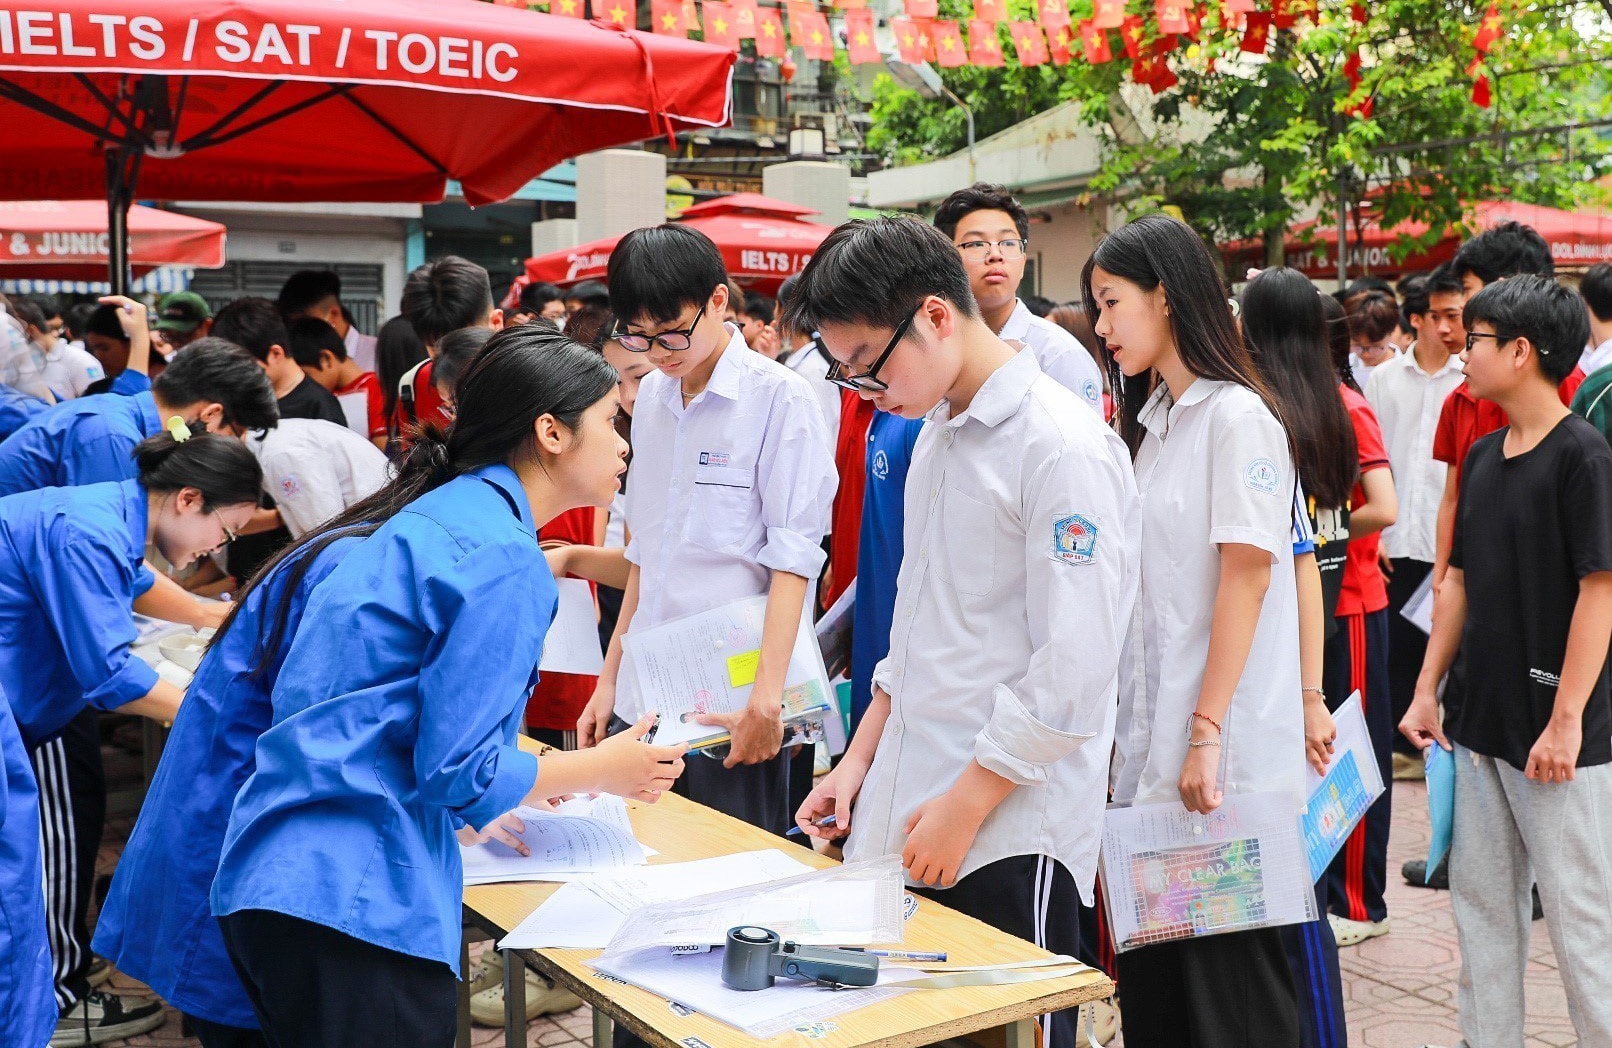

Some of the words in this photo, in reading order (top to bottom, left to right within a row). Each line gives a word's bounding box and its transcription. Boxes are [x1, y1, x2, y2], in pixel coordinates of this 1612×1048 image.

[0, 10, 166, 61] IELTS
[182, 19, 199, 61] /
[214, 20, 321, 66] SAT
[336, 27, 352, 68] /
[364, 29, 520, 83] TOEIC
[741, 249, 790, 272] IELTS
[1178, 863, 1227, 882] CLEAR
